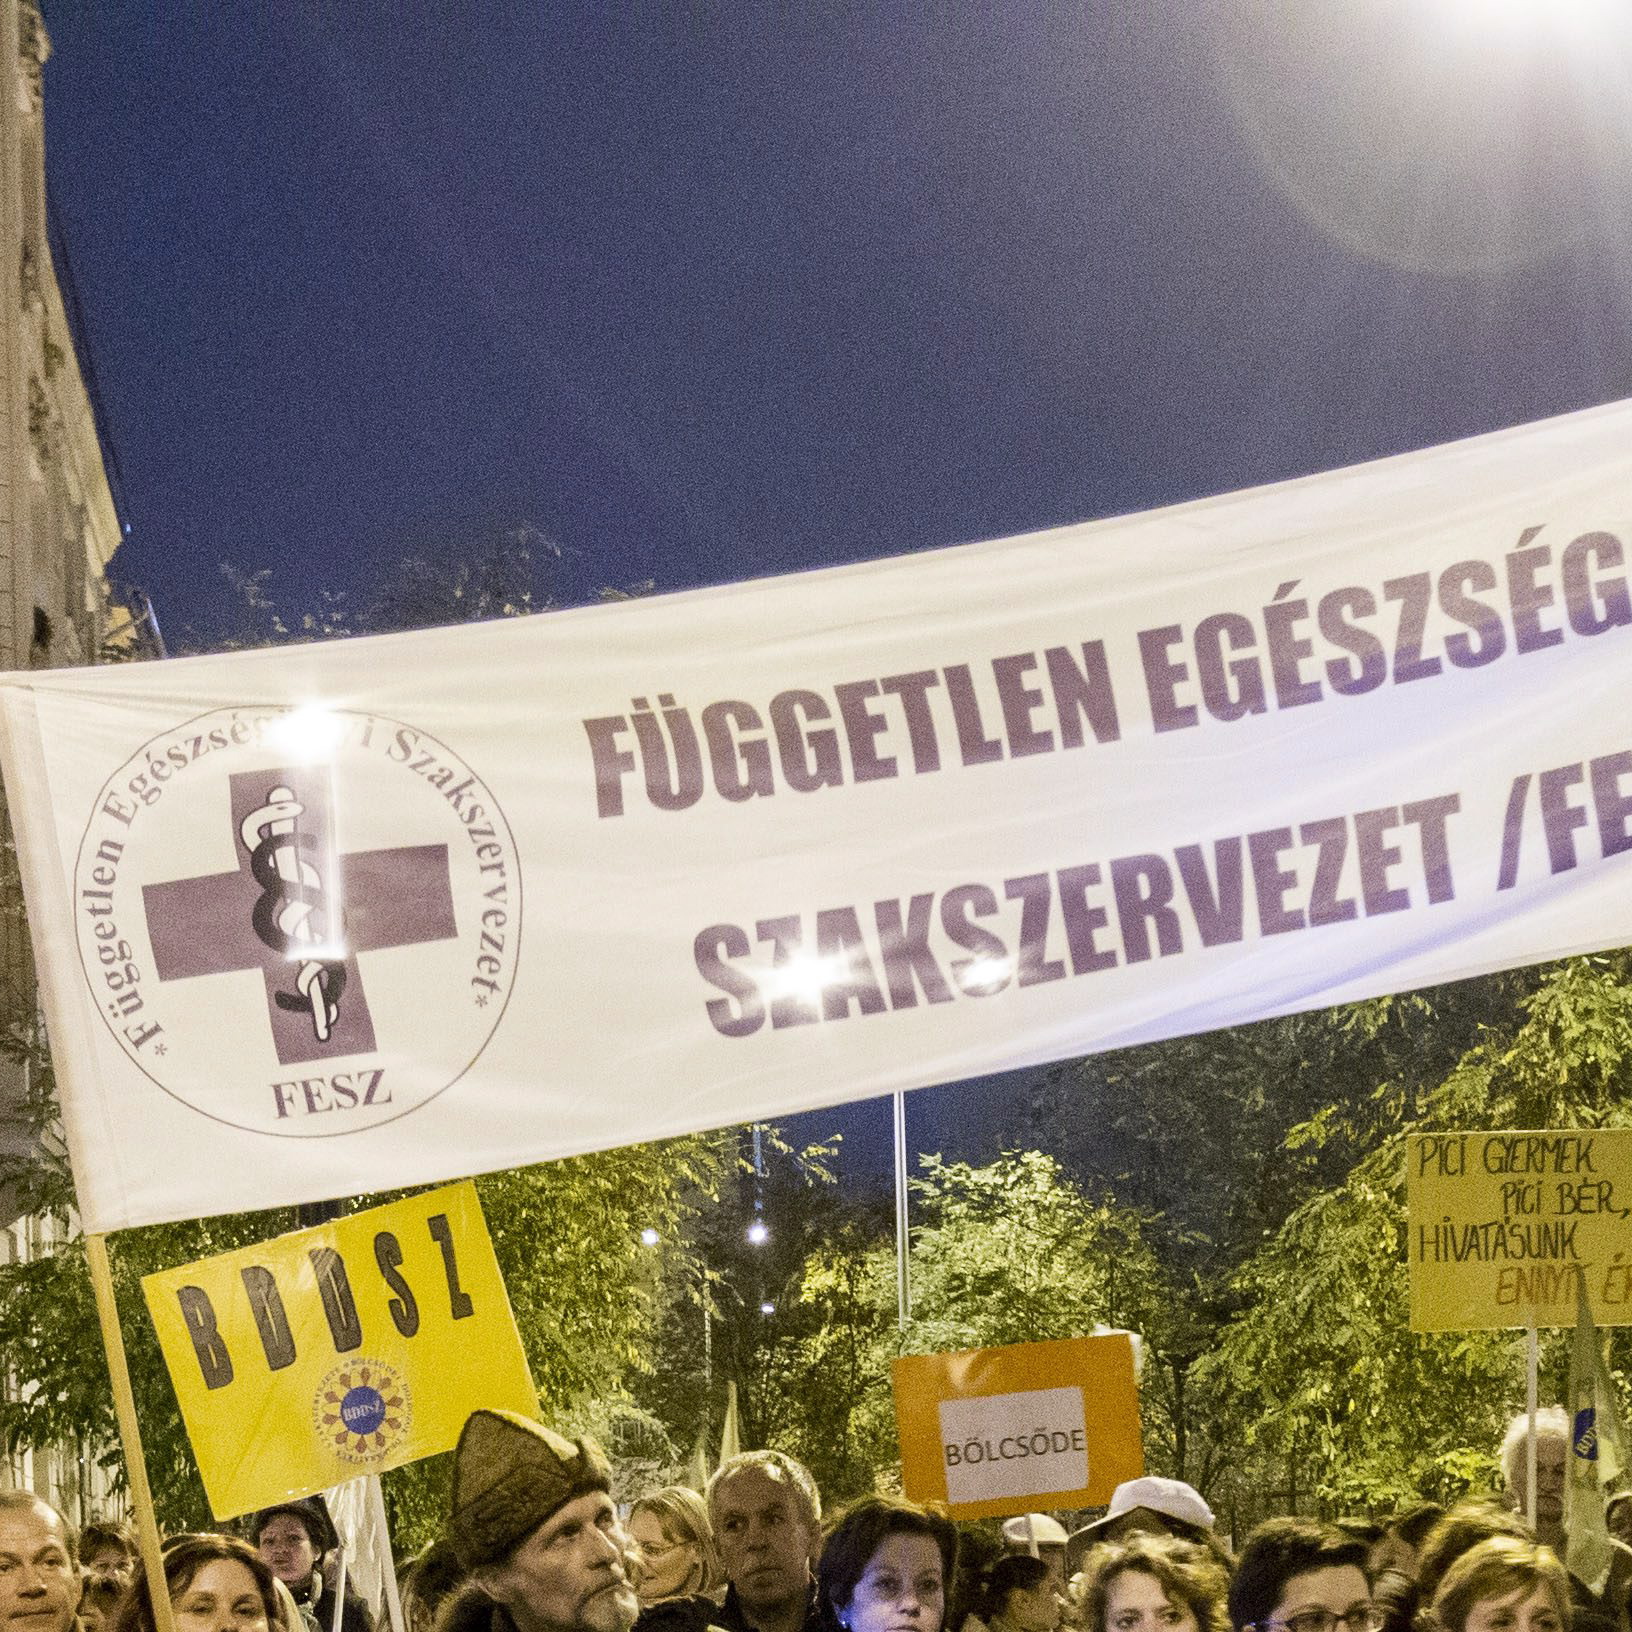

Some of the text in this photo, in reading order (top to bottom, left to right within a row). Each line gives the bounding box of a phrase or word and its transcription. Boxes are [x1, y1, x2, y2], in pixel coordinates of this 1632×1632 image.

[582, 639, 1121, 819] FÜGGETLEN
[82, 839, 165, 1053] Független
[385, 727, 508, 995] Szakszervezet
[693, 792, 1461, 1038] SZAKSZERVEZET
[270, 1068, 393, 1120] FESZ
[1483, 1135, 1597, 1174] GYERMEK
[176, 1213, 475, 1391] BDDSZ
[944, 1426, 1086, 1467] BÖLCSŐDE
